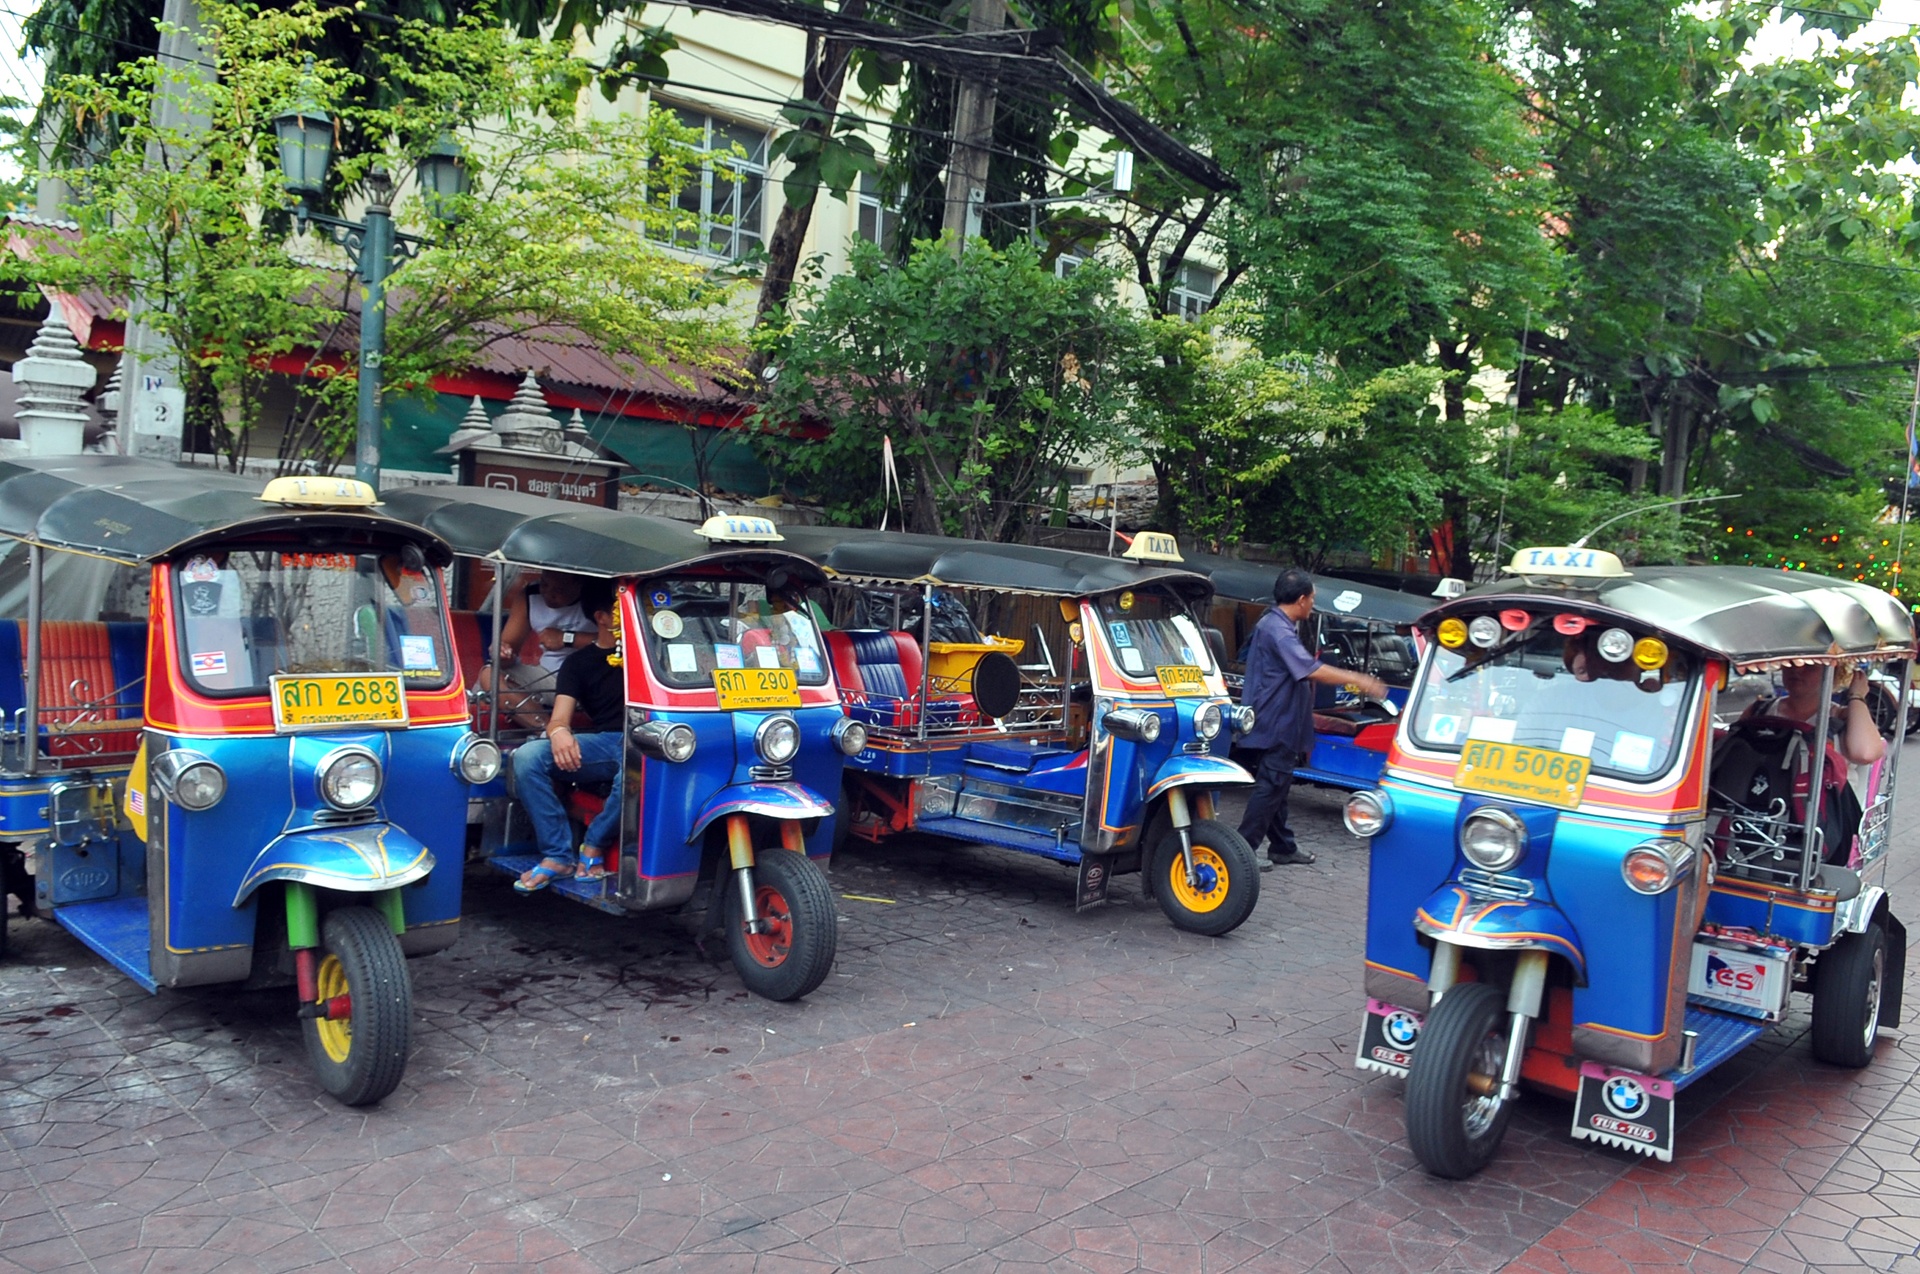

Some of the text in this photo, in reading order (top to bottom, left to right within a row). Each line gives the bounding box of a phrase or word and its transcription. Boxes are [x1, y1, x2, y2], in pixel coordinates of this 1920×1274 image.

[155, 405, 167, 422] 2
[294, 480, 363, 498] TXI
[726, 519, 772, 534] TAXI
[1148, 536, 1175, 555] TAXI
[1530, 550, 1596, 568] TAXI
[719, 671, 789, 691] สก 290
[1160, 668, 1204, 685] สก 5229
[281, 680, 400, 708] สก 2683
[301, 712, 389, 723] กรงเทพมหานคร
[1466, 743, 1583, 784] สก 5068
[1376, 1048, 1413, 1066] TUK-T
[1595, 1116, 1652, 1139] TUK-TUK
